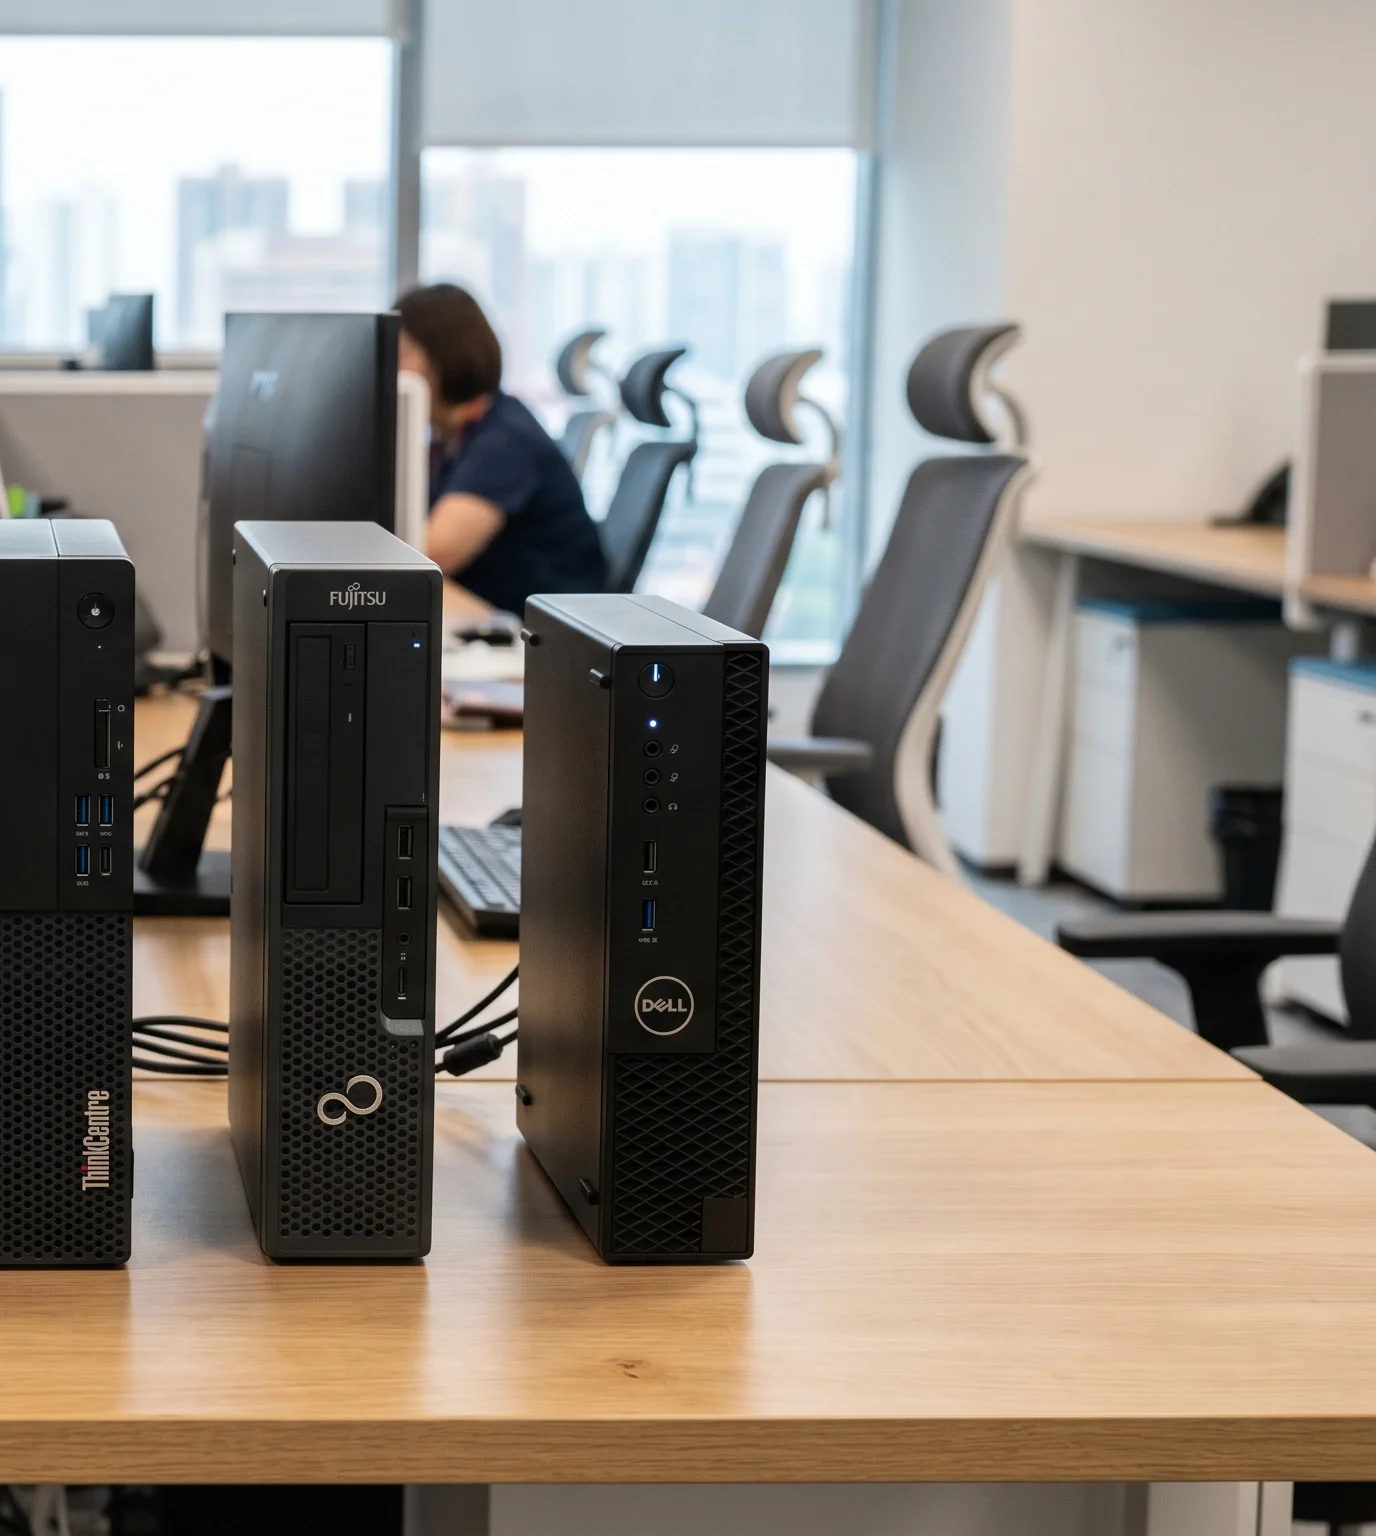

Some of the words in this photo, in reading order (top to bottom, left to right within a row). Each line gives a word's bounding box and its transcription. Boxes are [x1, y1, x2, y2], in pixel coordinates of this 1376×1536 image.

[329, 582, 386, 610] FUJITSU
[642, 998, 688, 1013] DELL
[81, 1090, 110, 1191] ThinkCentre
